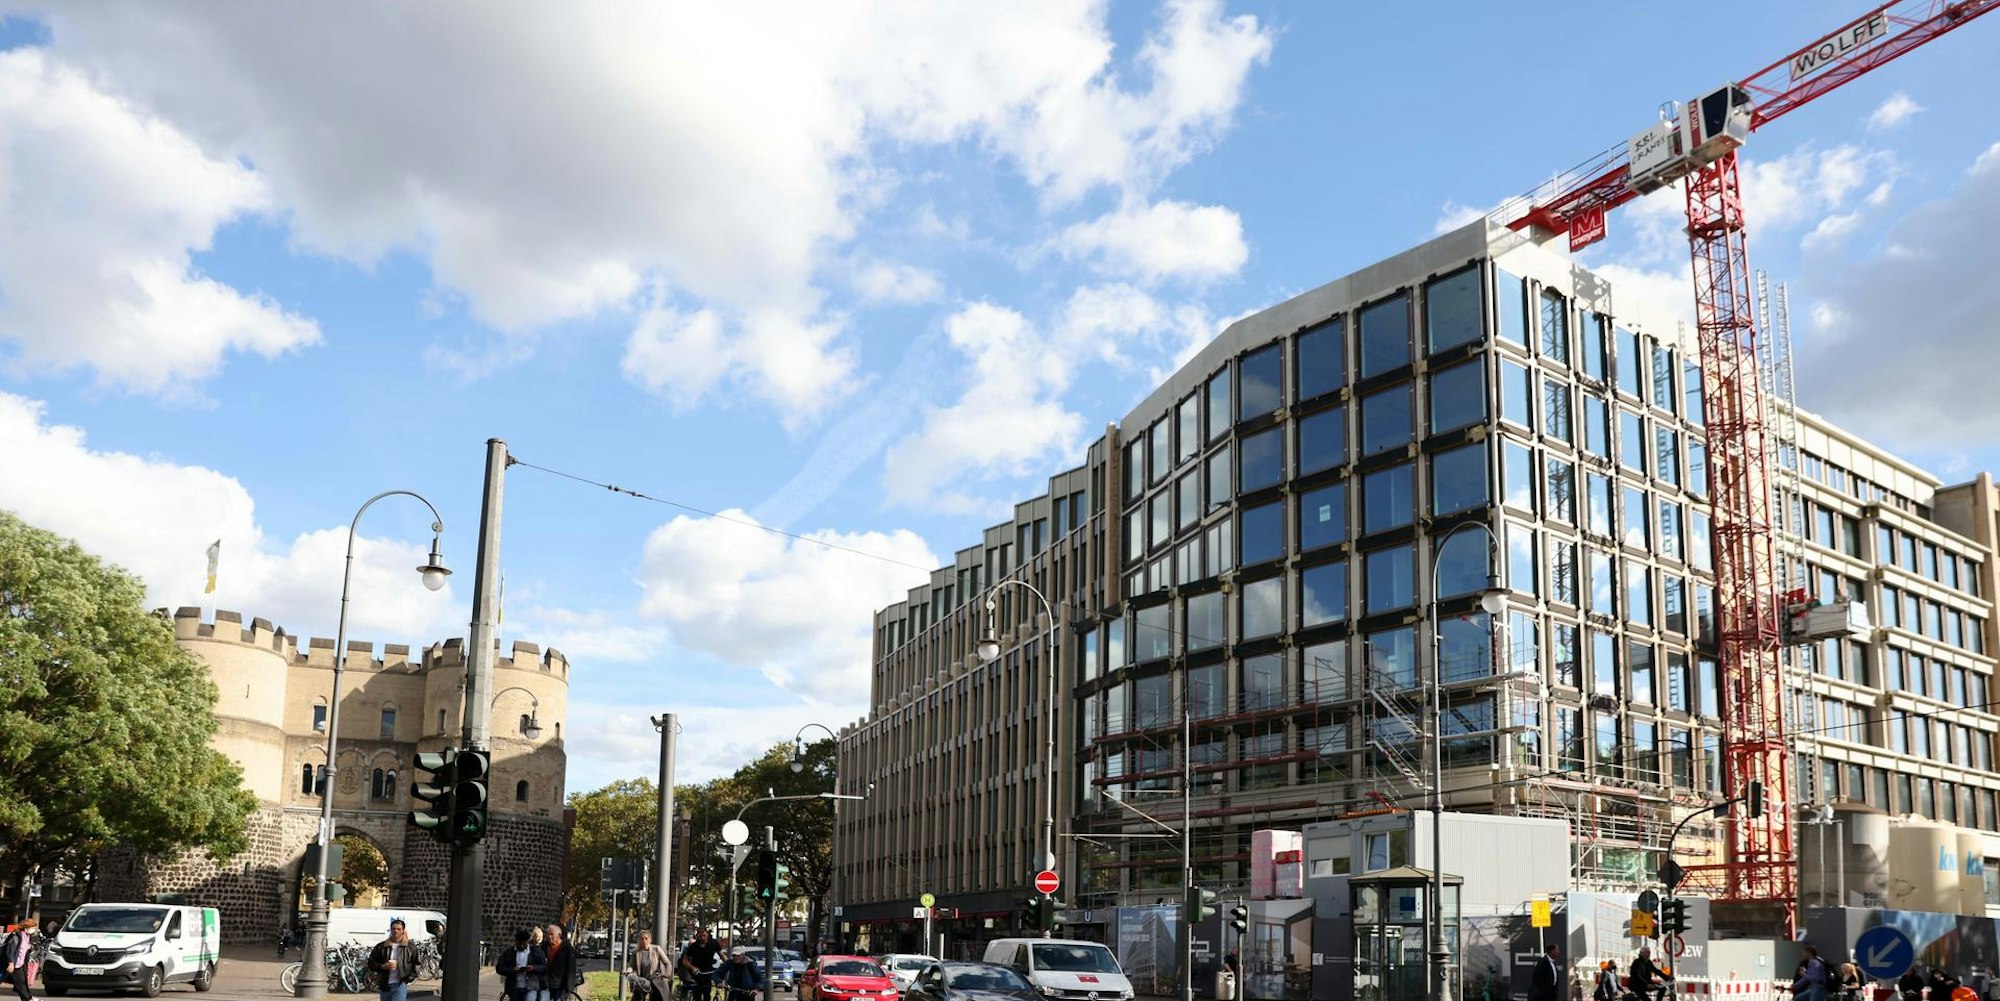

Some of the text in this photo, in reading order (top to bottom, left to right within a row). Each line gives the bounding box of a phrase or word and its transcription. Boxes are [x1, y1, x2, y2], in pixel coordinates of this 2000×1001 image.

[1796, 15, 1883, 72] WOLFF
[1571, 205, 1603, 239] M
[1084, 911, 1092, 922] U
[1681, 945, 1704, 958] EW
